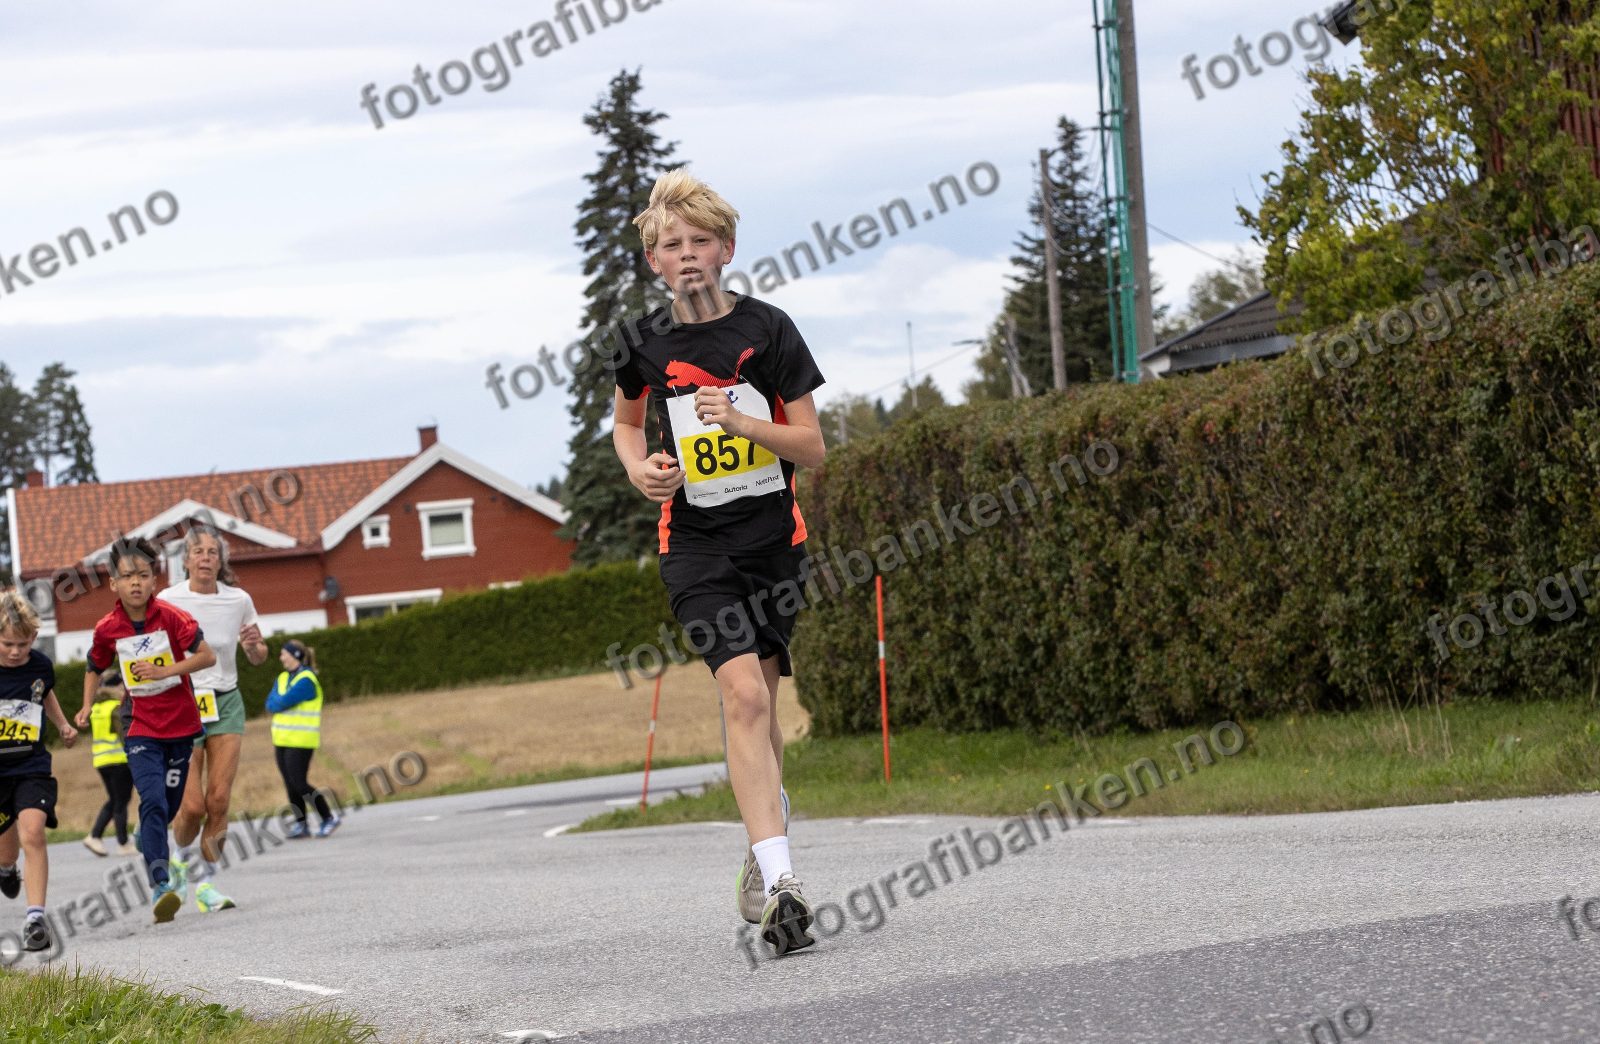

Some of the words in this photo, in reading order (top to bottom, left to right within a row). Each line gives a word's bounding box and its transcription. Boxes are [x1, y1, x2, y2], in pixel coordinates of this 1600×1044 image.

[694, 434, 755, 475] 857
[130, 657, 165, 682] 98
[166, 769, 181, 787] 6
